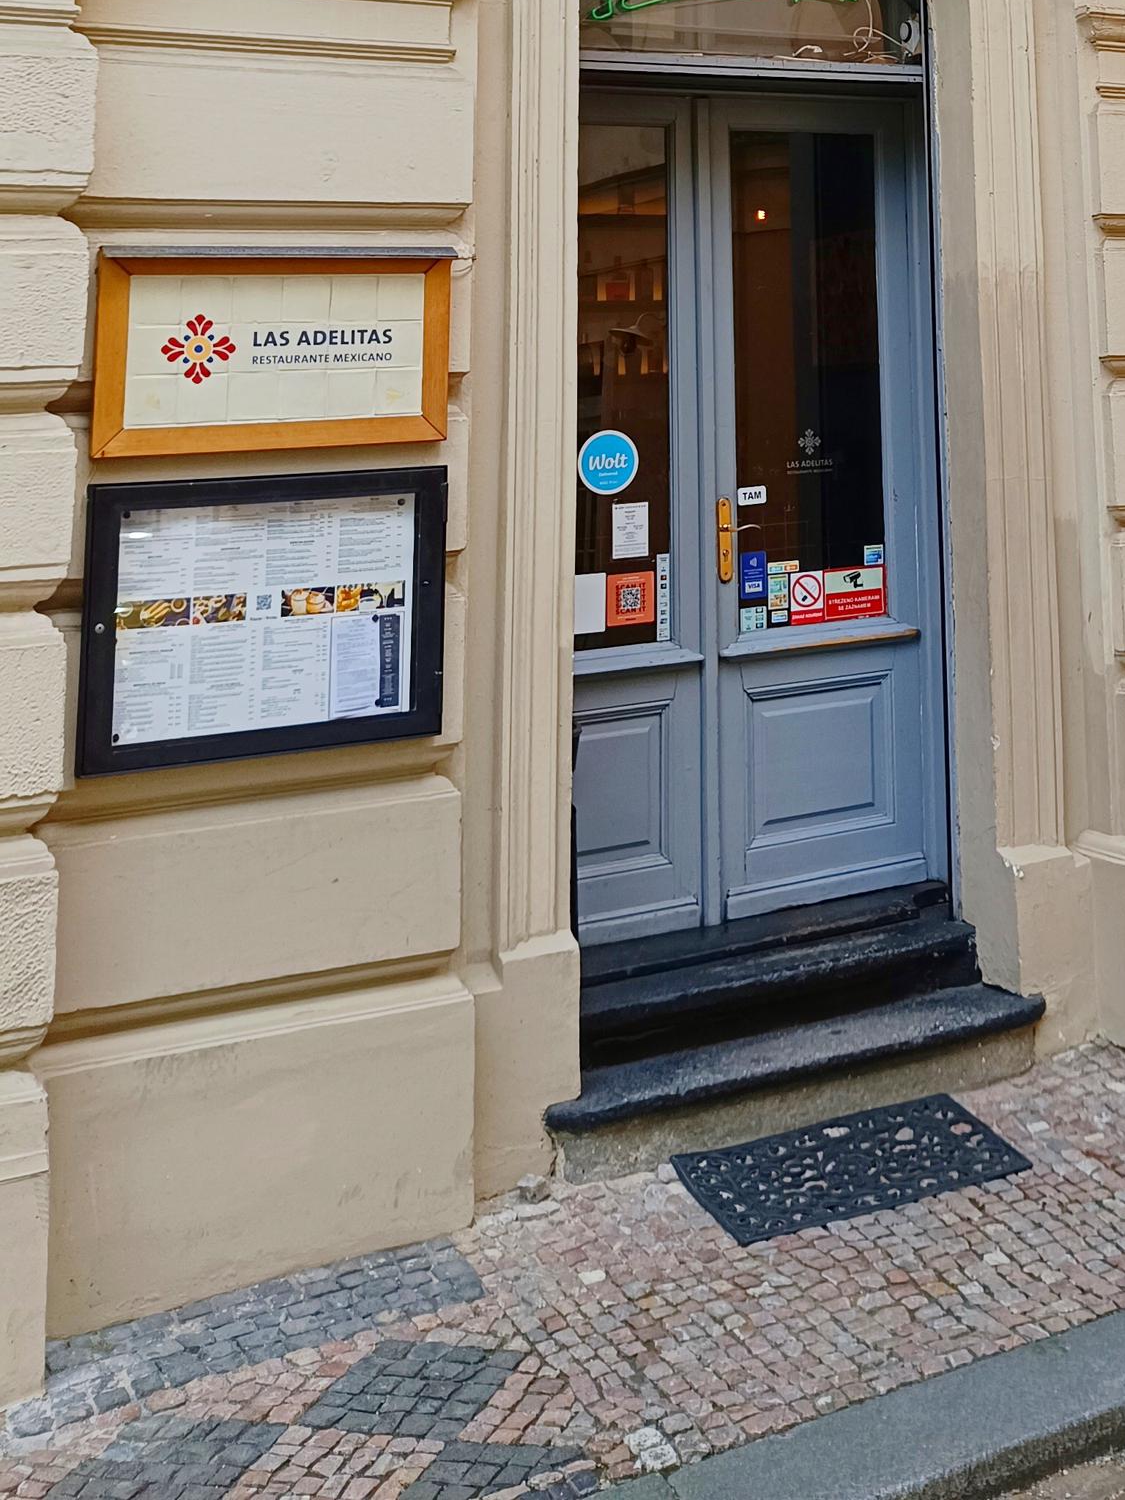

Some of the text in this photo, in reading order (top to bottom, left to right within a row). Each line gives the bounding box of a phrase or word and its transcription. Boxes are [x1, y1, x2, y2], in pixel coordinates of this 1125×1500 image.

[252, 329, 393, 347] LAS ADELITAS
[252, 352, 393, 365] RESTAURANTE MEXICANO
[589, 452, 628, 470] Wolt
[801, 459, 833, 467] ADELITAS
[742, 491, 761, 500] TAM
